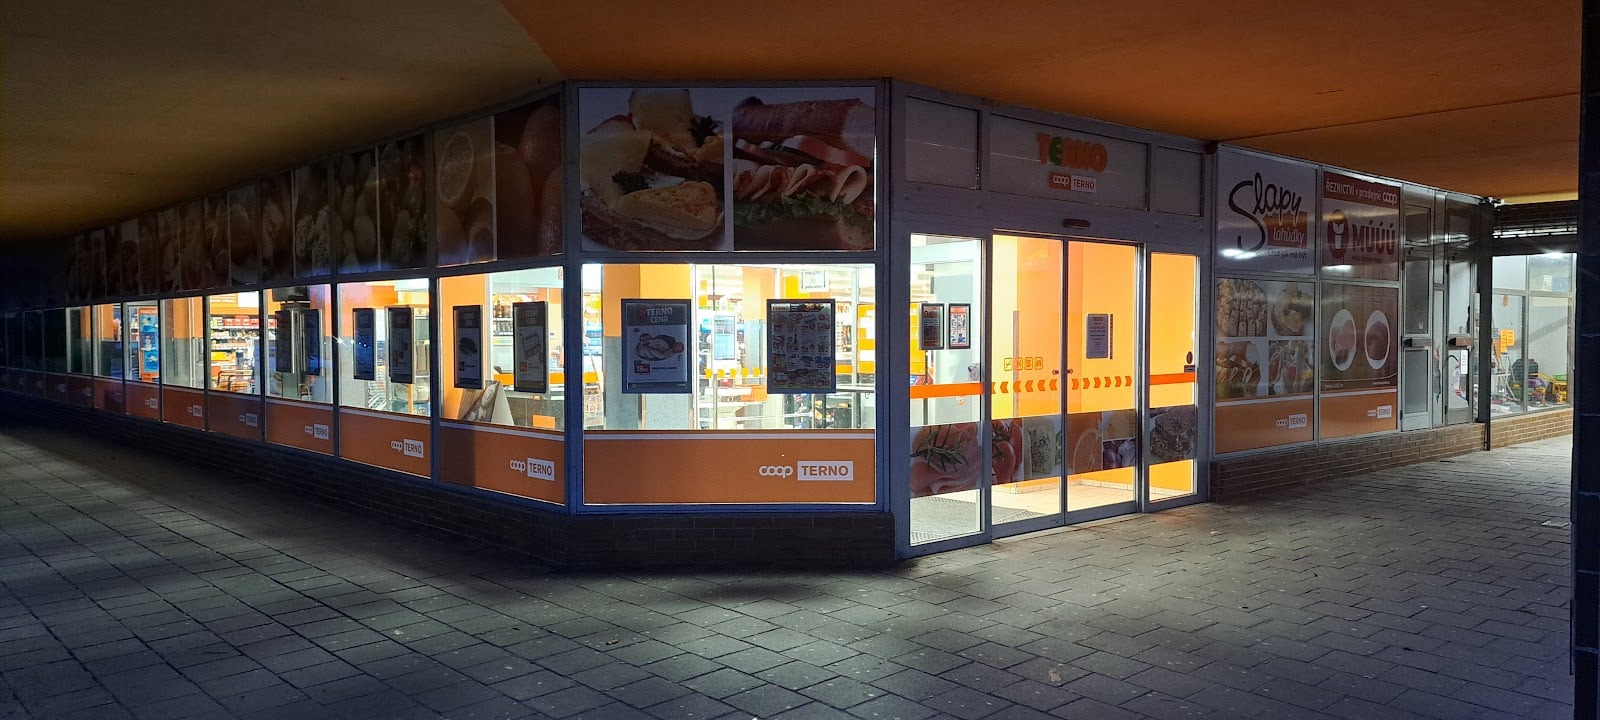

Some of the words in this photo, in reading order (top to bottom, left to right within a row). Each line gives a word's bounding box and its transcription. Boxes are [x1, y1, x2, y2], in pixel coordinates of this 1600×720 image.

[1037, 132, 1108, 173] TERNO
[1053, 175, 1070, 186] coop
[1073, 178, 1095, 190] TERNO
[1382, 191, 1397, 206] coop
[1228, 172, 1302, 251] Slapy
[646, 307, 673, 317] TERNO
[404, 441, 423, 455] TERNO
[509, 459, 527, 473] coop
[529, 462, 553, 477] TERNO
[759, 465, 794, 478] coop
[800, 464, 849, 477] TERNO
